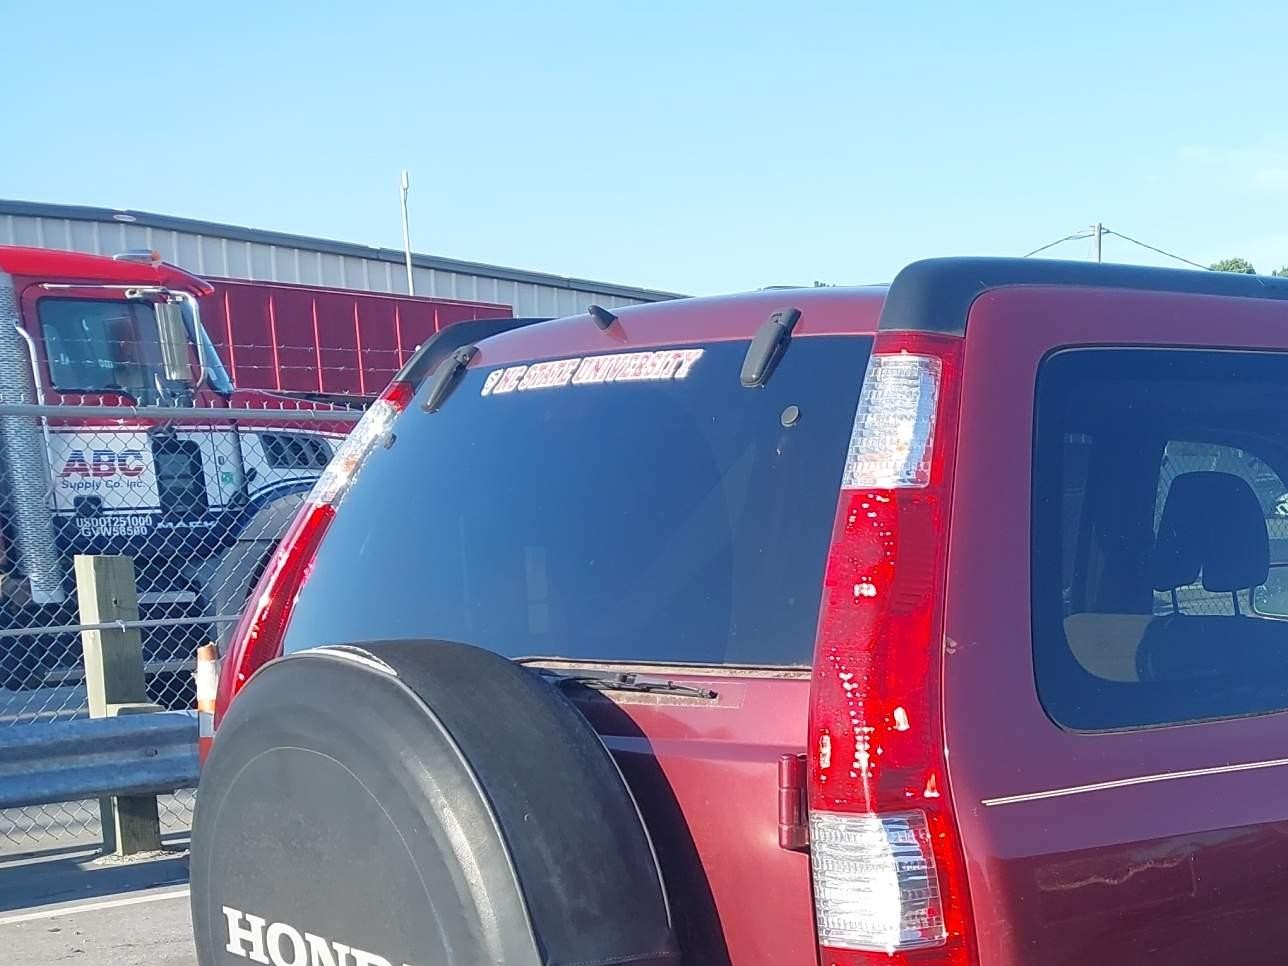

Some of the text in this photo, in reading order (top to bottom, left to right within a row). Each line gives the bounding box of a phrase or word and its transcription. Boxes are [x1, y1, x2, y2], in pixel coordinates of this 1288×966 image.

[572, 349, 704, 384] UNIVERSITY
[60, 449, 145, 477] ABC
[62, 479, 146, 491] Supply Co. Inc.
